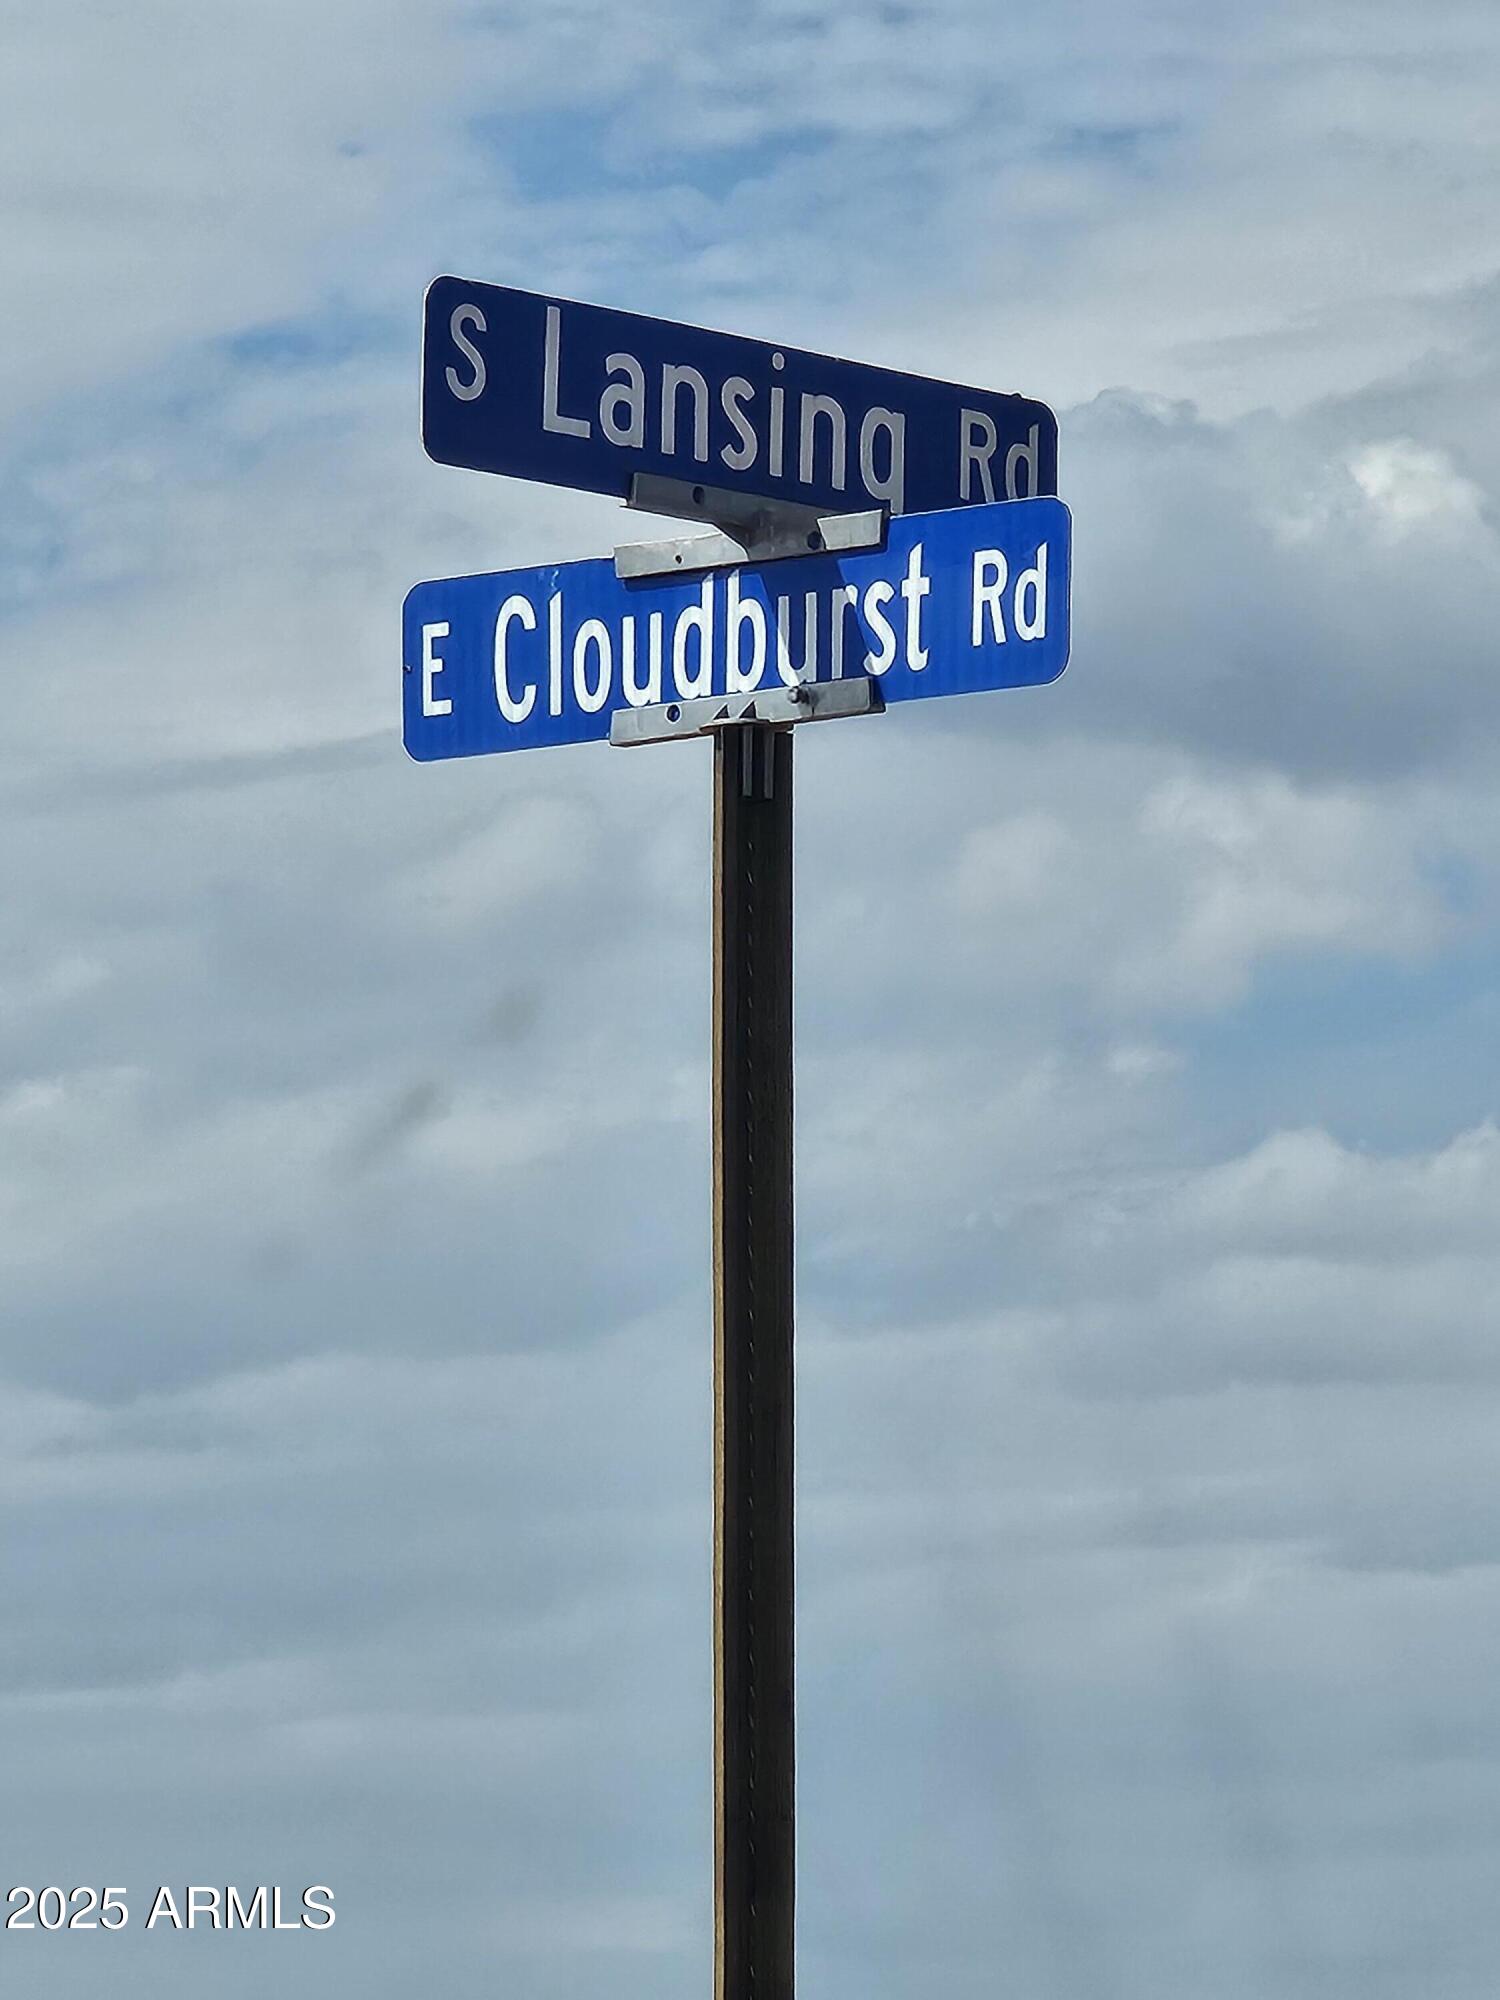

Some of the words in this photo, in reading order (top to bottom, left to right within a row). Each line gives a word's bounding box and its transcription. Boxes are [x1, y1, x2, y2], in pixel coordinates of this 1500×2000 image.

[445, 303, 487, 401] S
[543, 306, 905, 514] Lansing
[960, 408, 1039, 503] Rd
[422, 621, 452, 717] E
[494, 542, 930, 723] Cloudburst
[972, 542, 1047, 647] Rd
